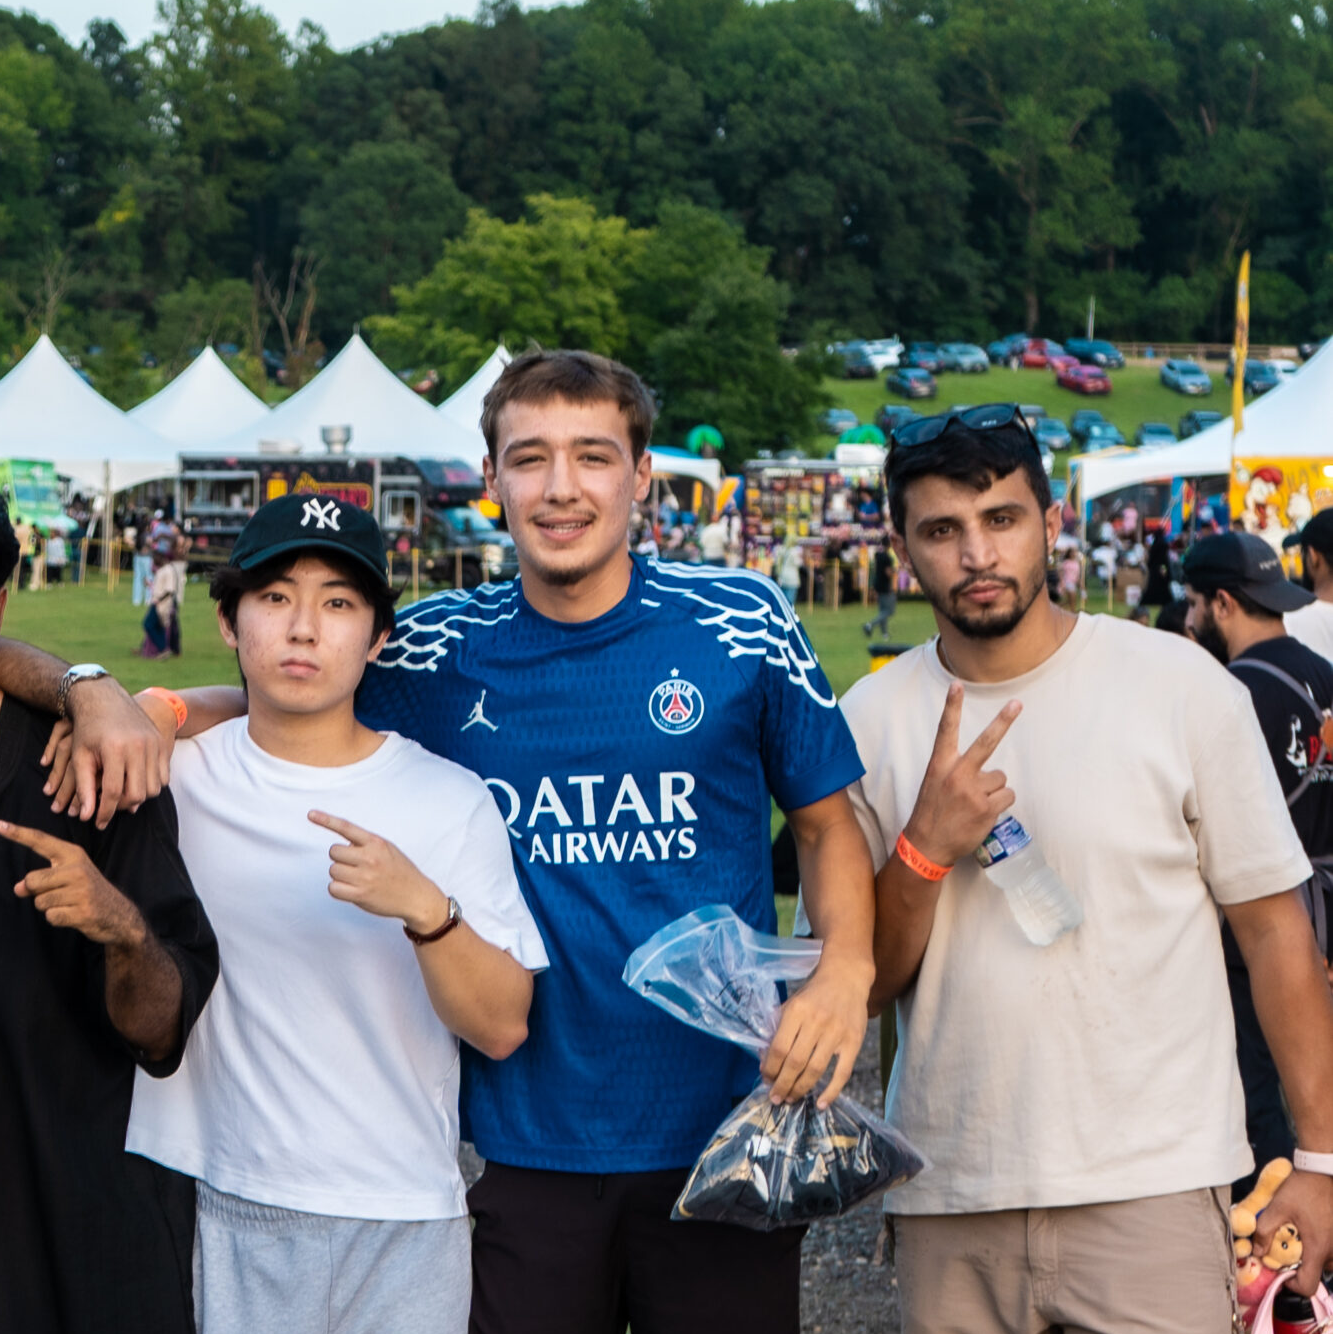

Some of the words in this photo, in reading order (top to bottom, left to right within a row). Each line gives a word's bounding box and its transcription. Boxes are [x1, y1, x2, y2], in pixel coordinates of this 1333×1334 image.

[300, 498, 341, 531] NY
[657, 681, 694, 697] PARIS
[528, 827, 697, 865] AIRWAYS
